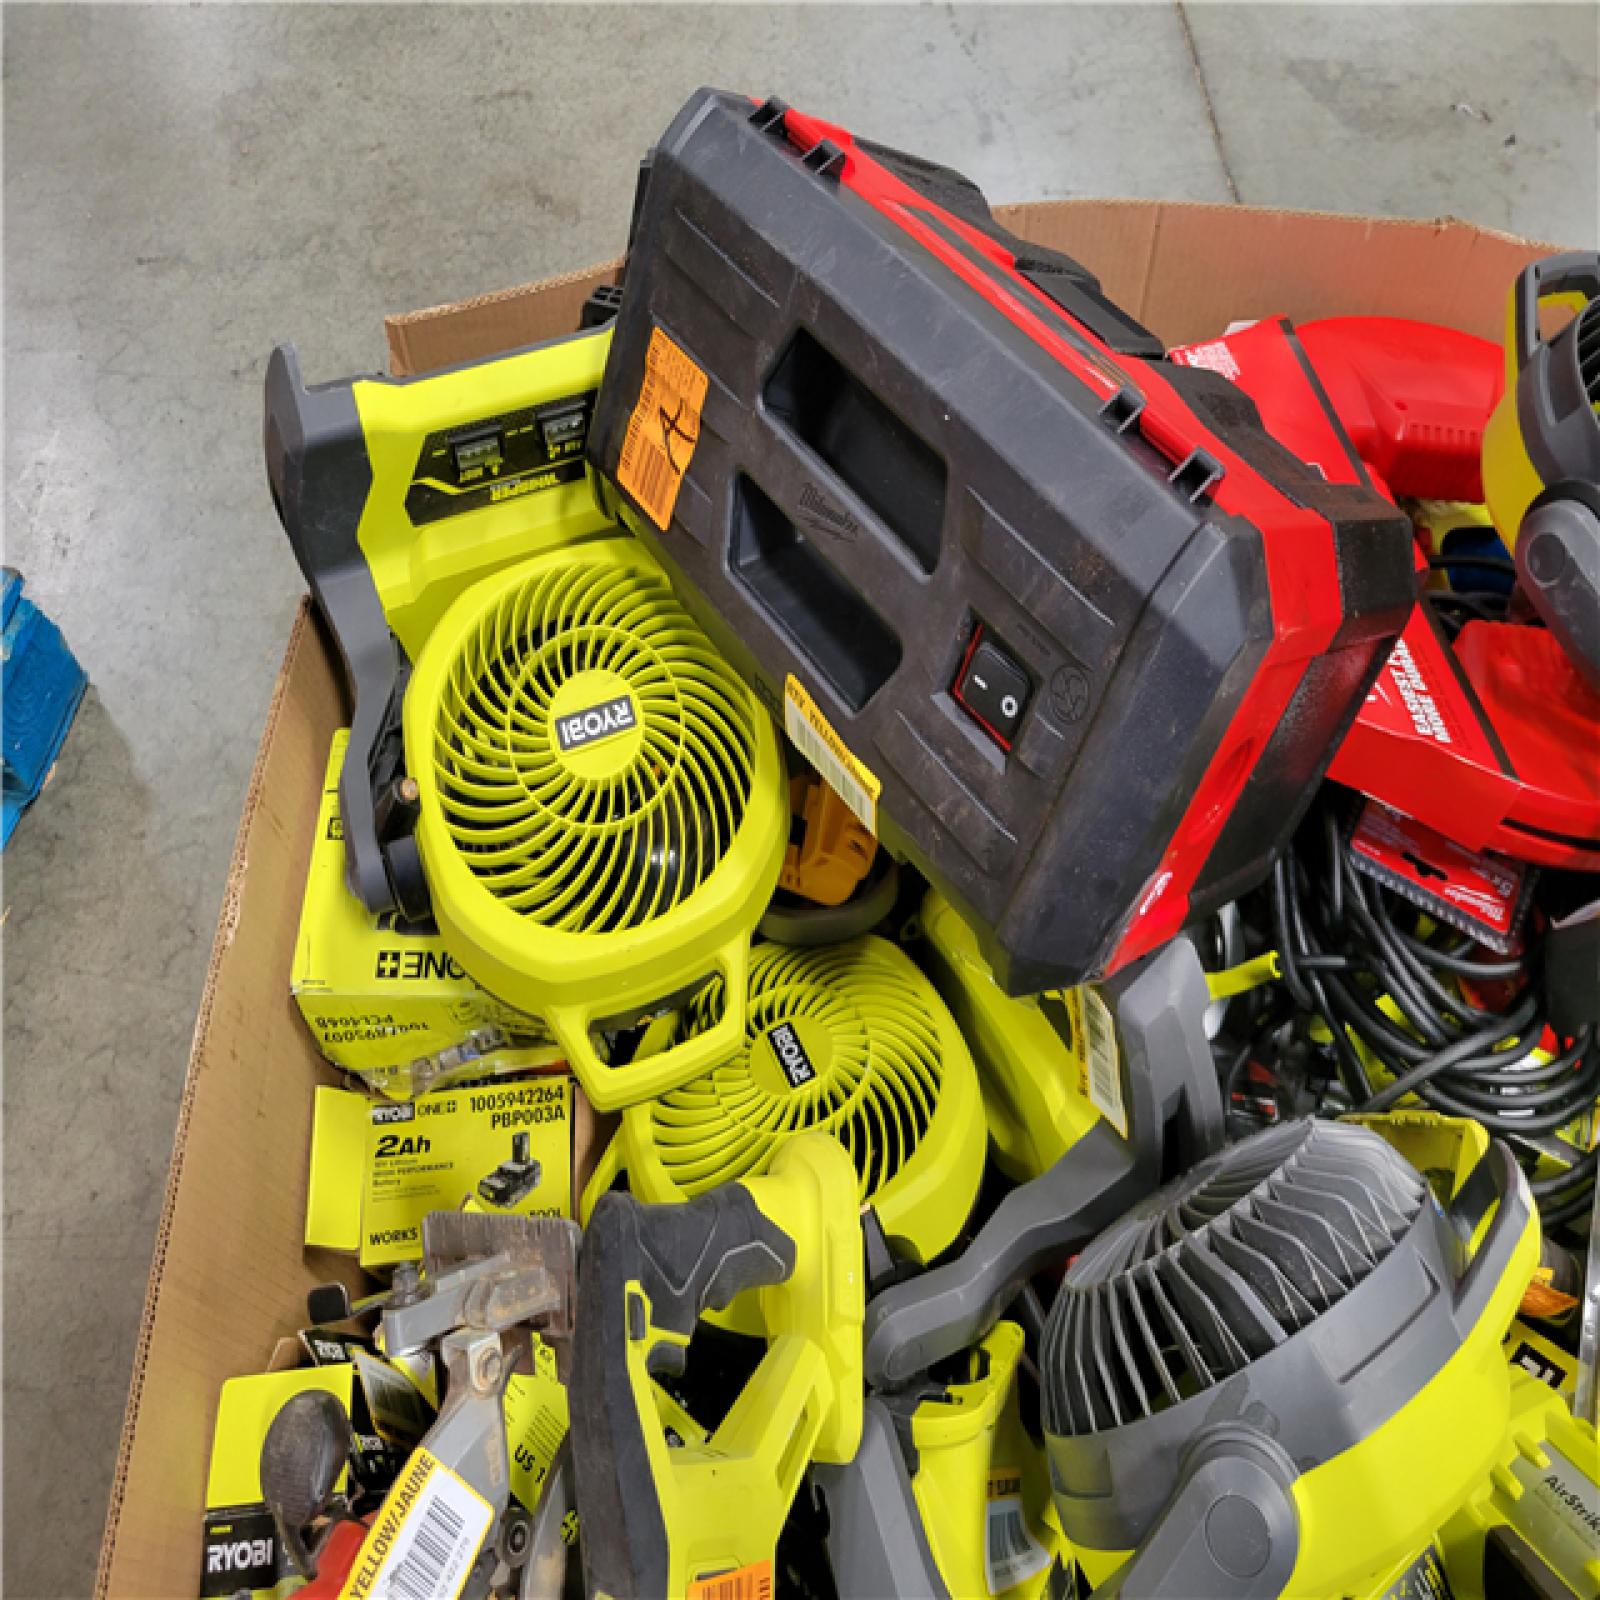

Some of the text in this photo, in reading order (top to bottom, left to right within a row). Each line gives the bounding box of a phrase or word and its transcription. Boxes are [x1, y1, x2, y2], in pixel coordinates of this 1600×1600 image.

[560, 700, 634, 745] RYOBI
[771, 1025, 811, 1088] RYOBI
[469, 1085, 564, 1112] 1005942264
[374, 1134, 432, 1158] 2Ah
[369, 1227, 418, 1246] WORKS
[513, 1443, 536, 1474] US
[350, 1451, 436, 1600] YELLOW/JAUNE
[206, 1536, 274, 1574] RYOBI
